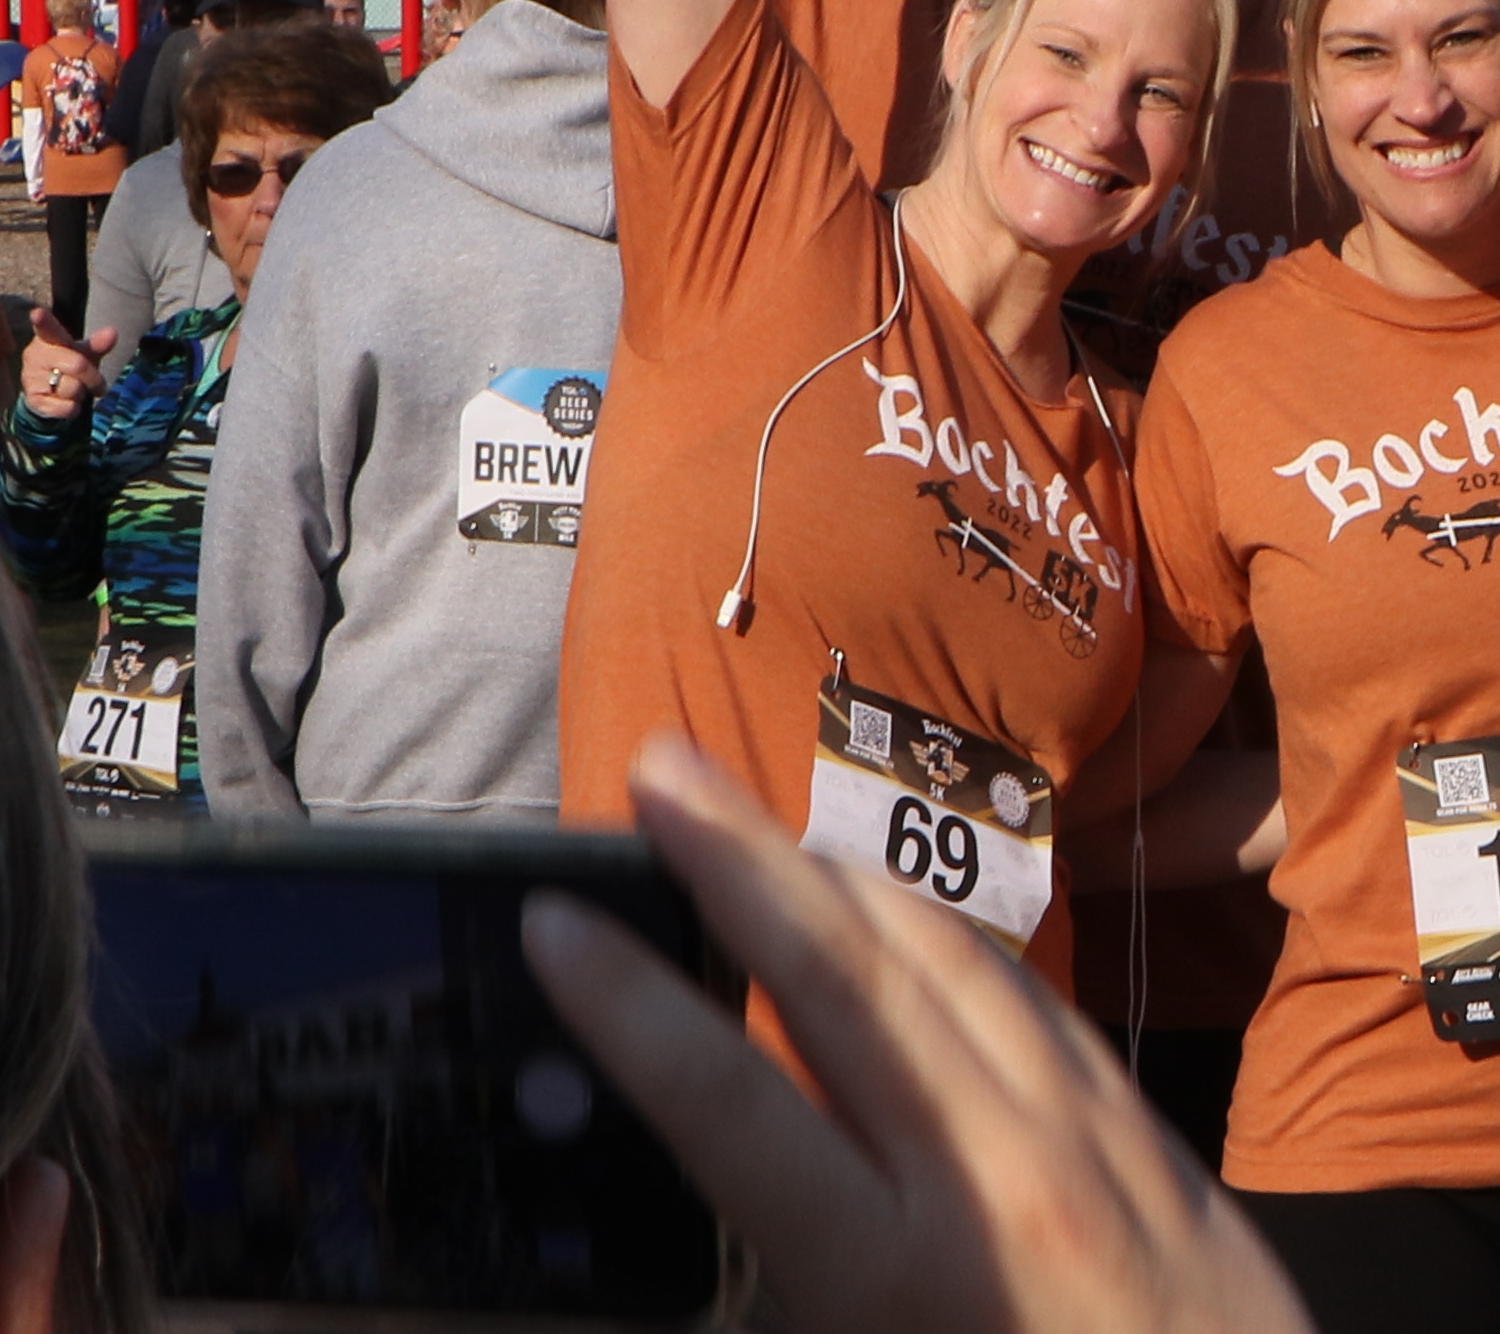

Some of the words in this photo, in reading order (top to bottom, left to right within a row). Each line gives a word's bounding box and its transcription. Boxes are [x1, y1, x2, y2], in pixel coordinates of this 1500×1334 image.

[1126, 183, 1288, 284] fes
[554, 408, 593, 421] SERIES
[560, 397, 588, 407] BEER
[474, 441, 583, 487] BREW
[985, 496, 1033, 540] 2022
[80, 696, 146, 760] 271
[929, 783, 945, 801] 5K
[886, 795, 980, 903] 69
